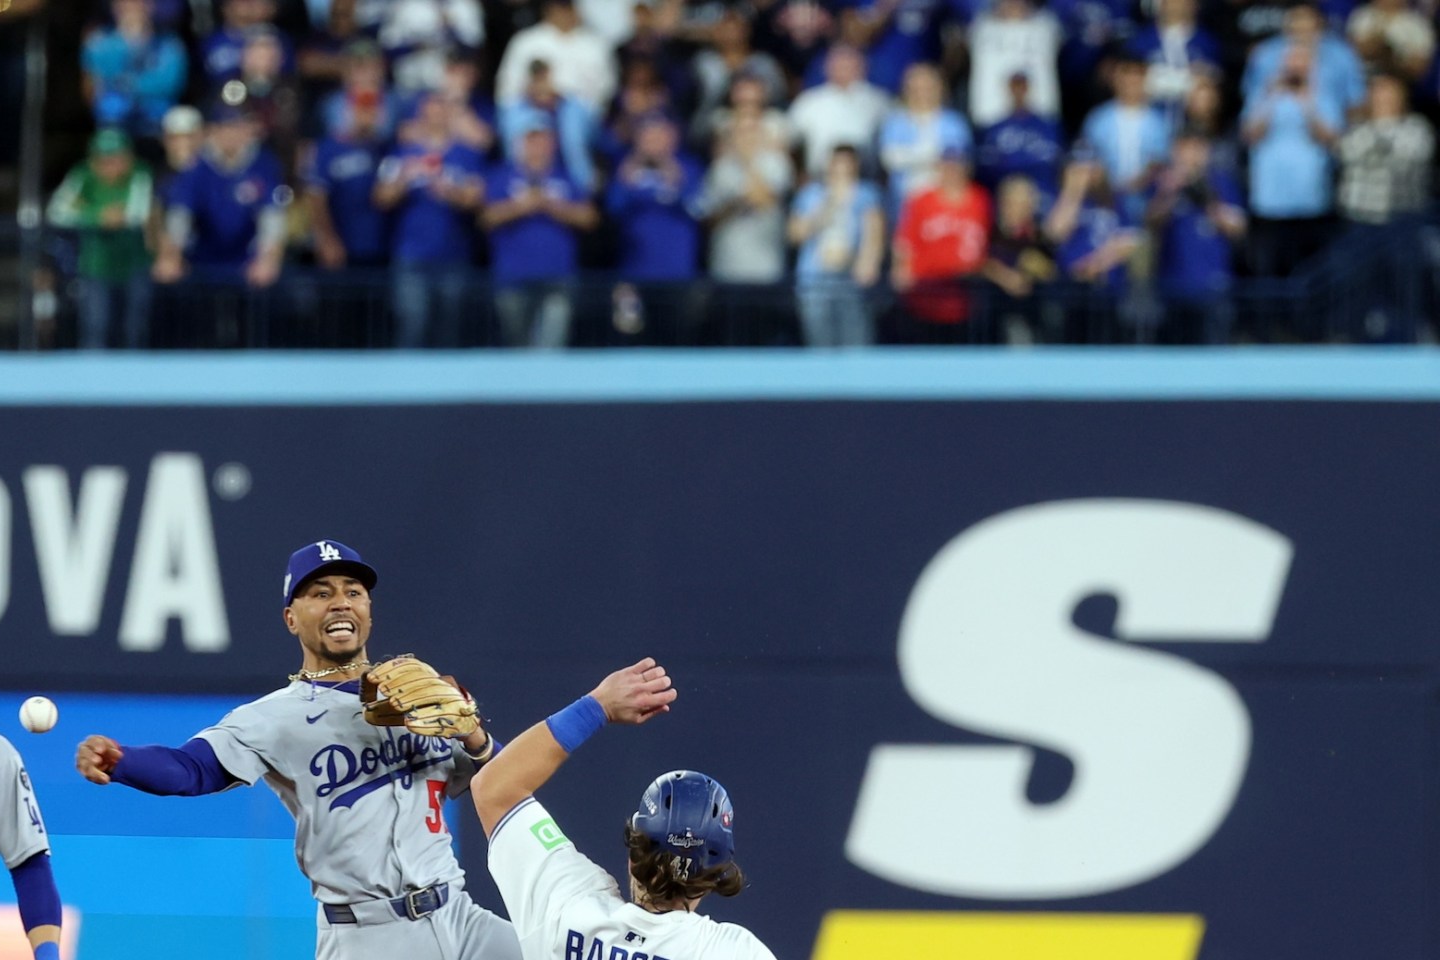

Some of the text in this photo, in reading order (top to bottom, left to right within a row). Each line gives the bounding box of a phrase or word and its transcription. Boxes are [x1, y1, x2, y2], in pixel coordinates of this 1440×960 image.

[316, 541, 342, 561] LA
[845, 498, 1294, 899] S
[425, 779, 449, 834] 5
